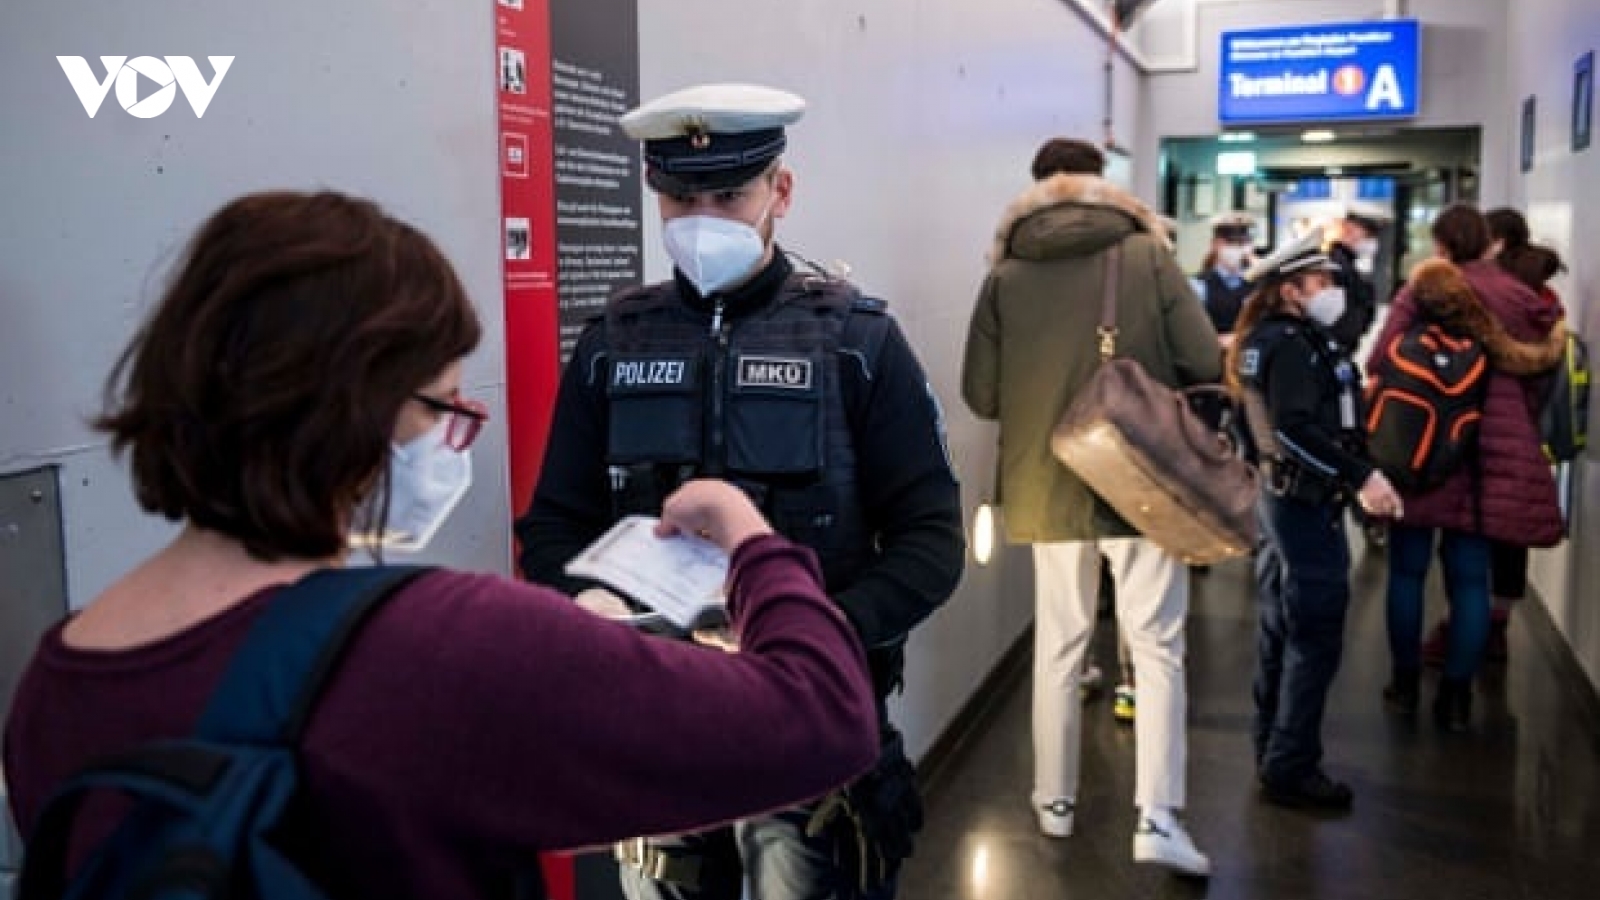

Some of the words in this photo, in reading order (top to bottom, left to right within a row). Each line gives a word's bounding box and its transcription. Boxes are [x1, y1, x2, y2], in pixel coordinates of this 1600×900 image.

[1229, 70, 1328, 97] Terminal
[1365, 64, 1405, 109] A
[615, 361, 685, 385] POLIZEI
